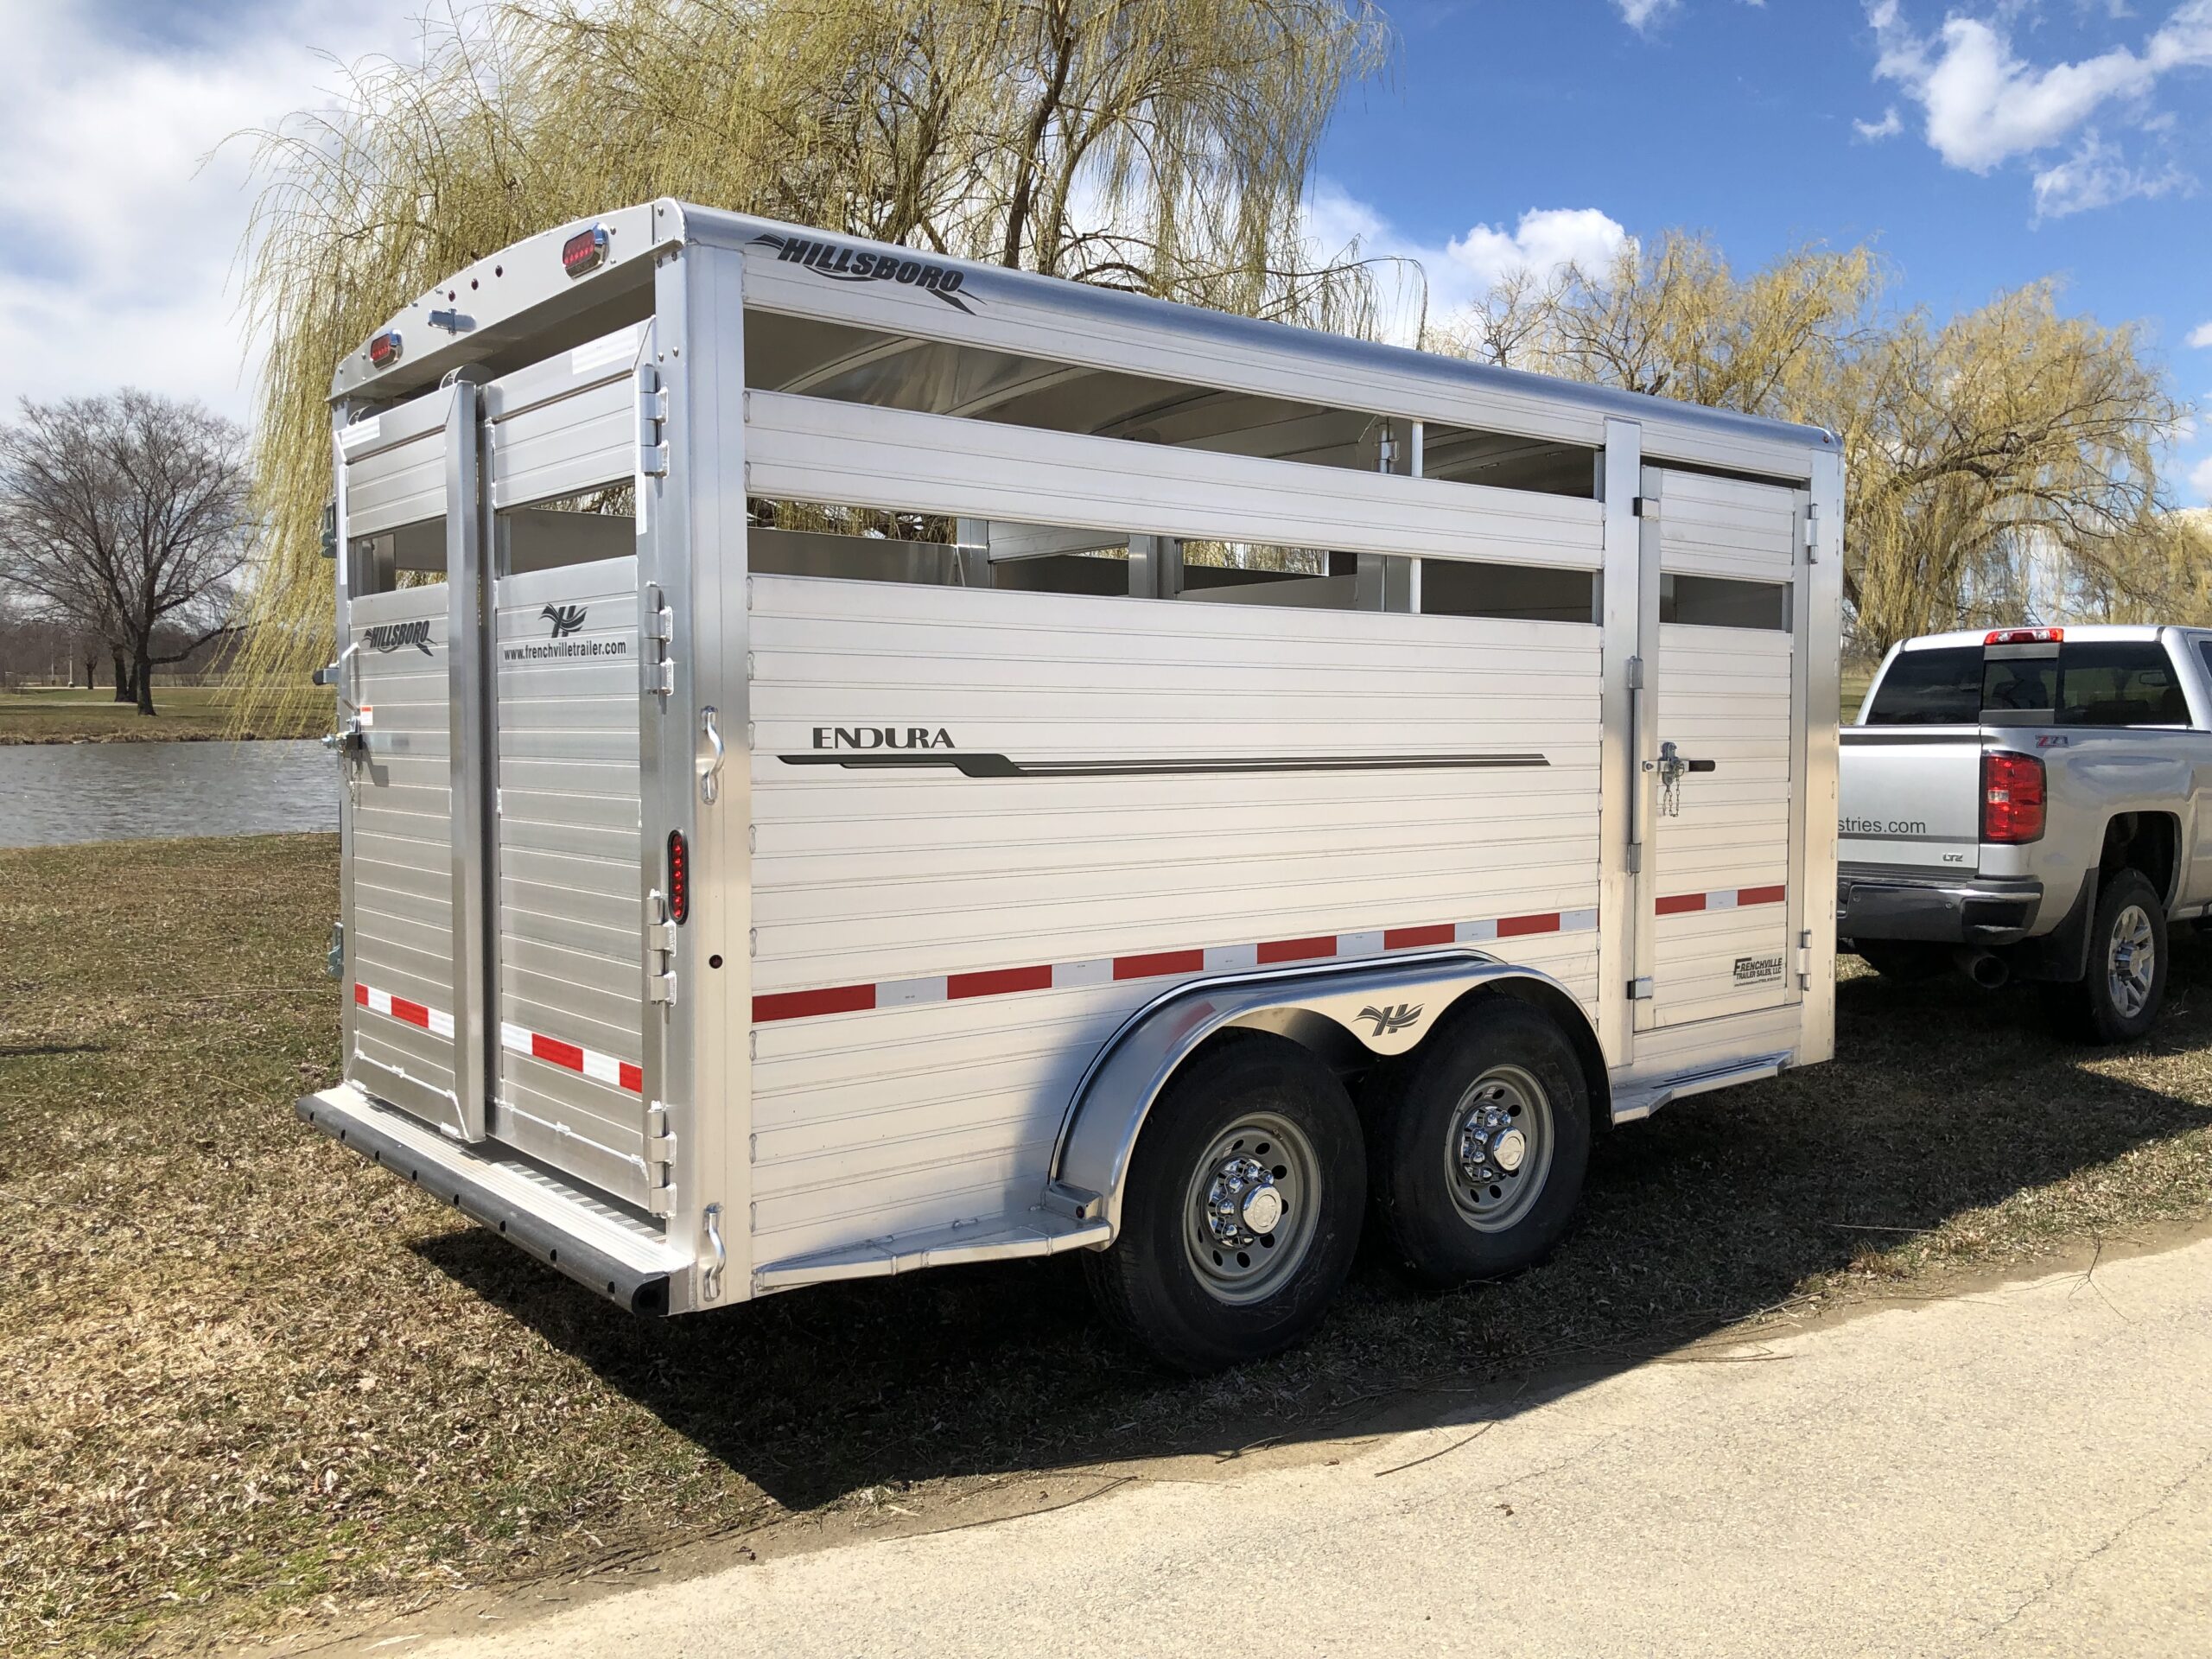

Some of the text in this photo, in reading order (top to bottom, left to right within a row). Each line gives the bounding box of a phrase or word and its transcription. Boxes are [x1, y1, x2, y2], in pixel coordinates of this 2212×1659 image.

[778, 237, 964, 292] HILLSBORO
[370, 620, 430, 648] HILLSBORO
[504, 639, 626, 661] www.frenchvilletrailer.com
[812, 727, 956, 749] ENDURA
[2036, 734, 2069, 748] Z71
[1942, 854, 1963, 862] LTZ
[1733, 957, 1783, 976] FRENCHVILLE
[1736, 970, 1756, 981] TRAILER
[1772, 966, 1783, 975] LLC
